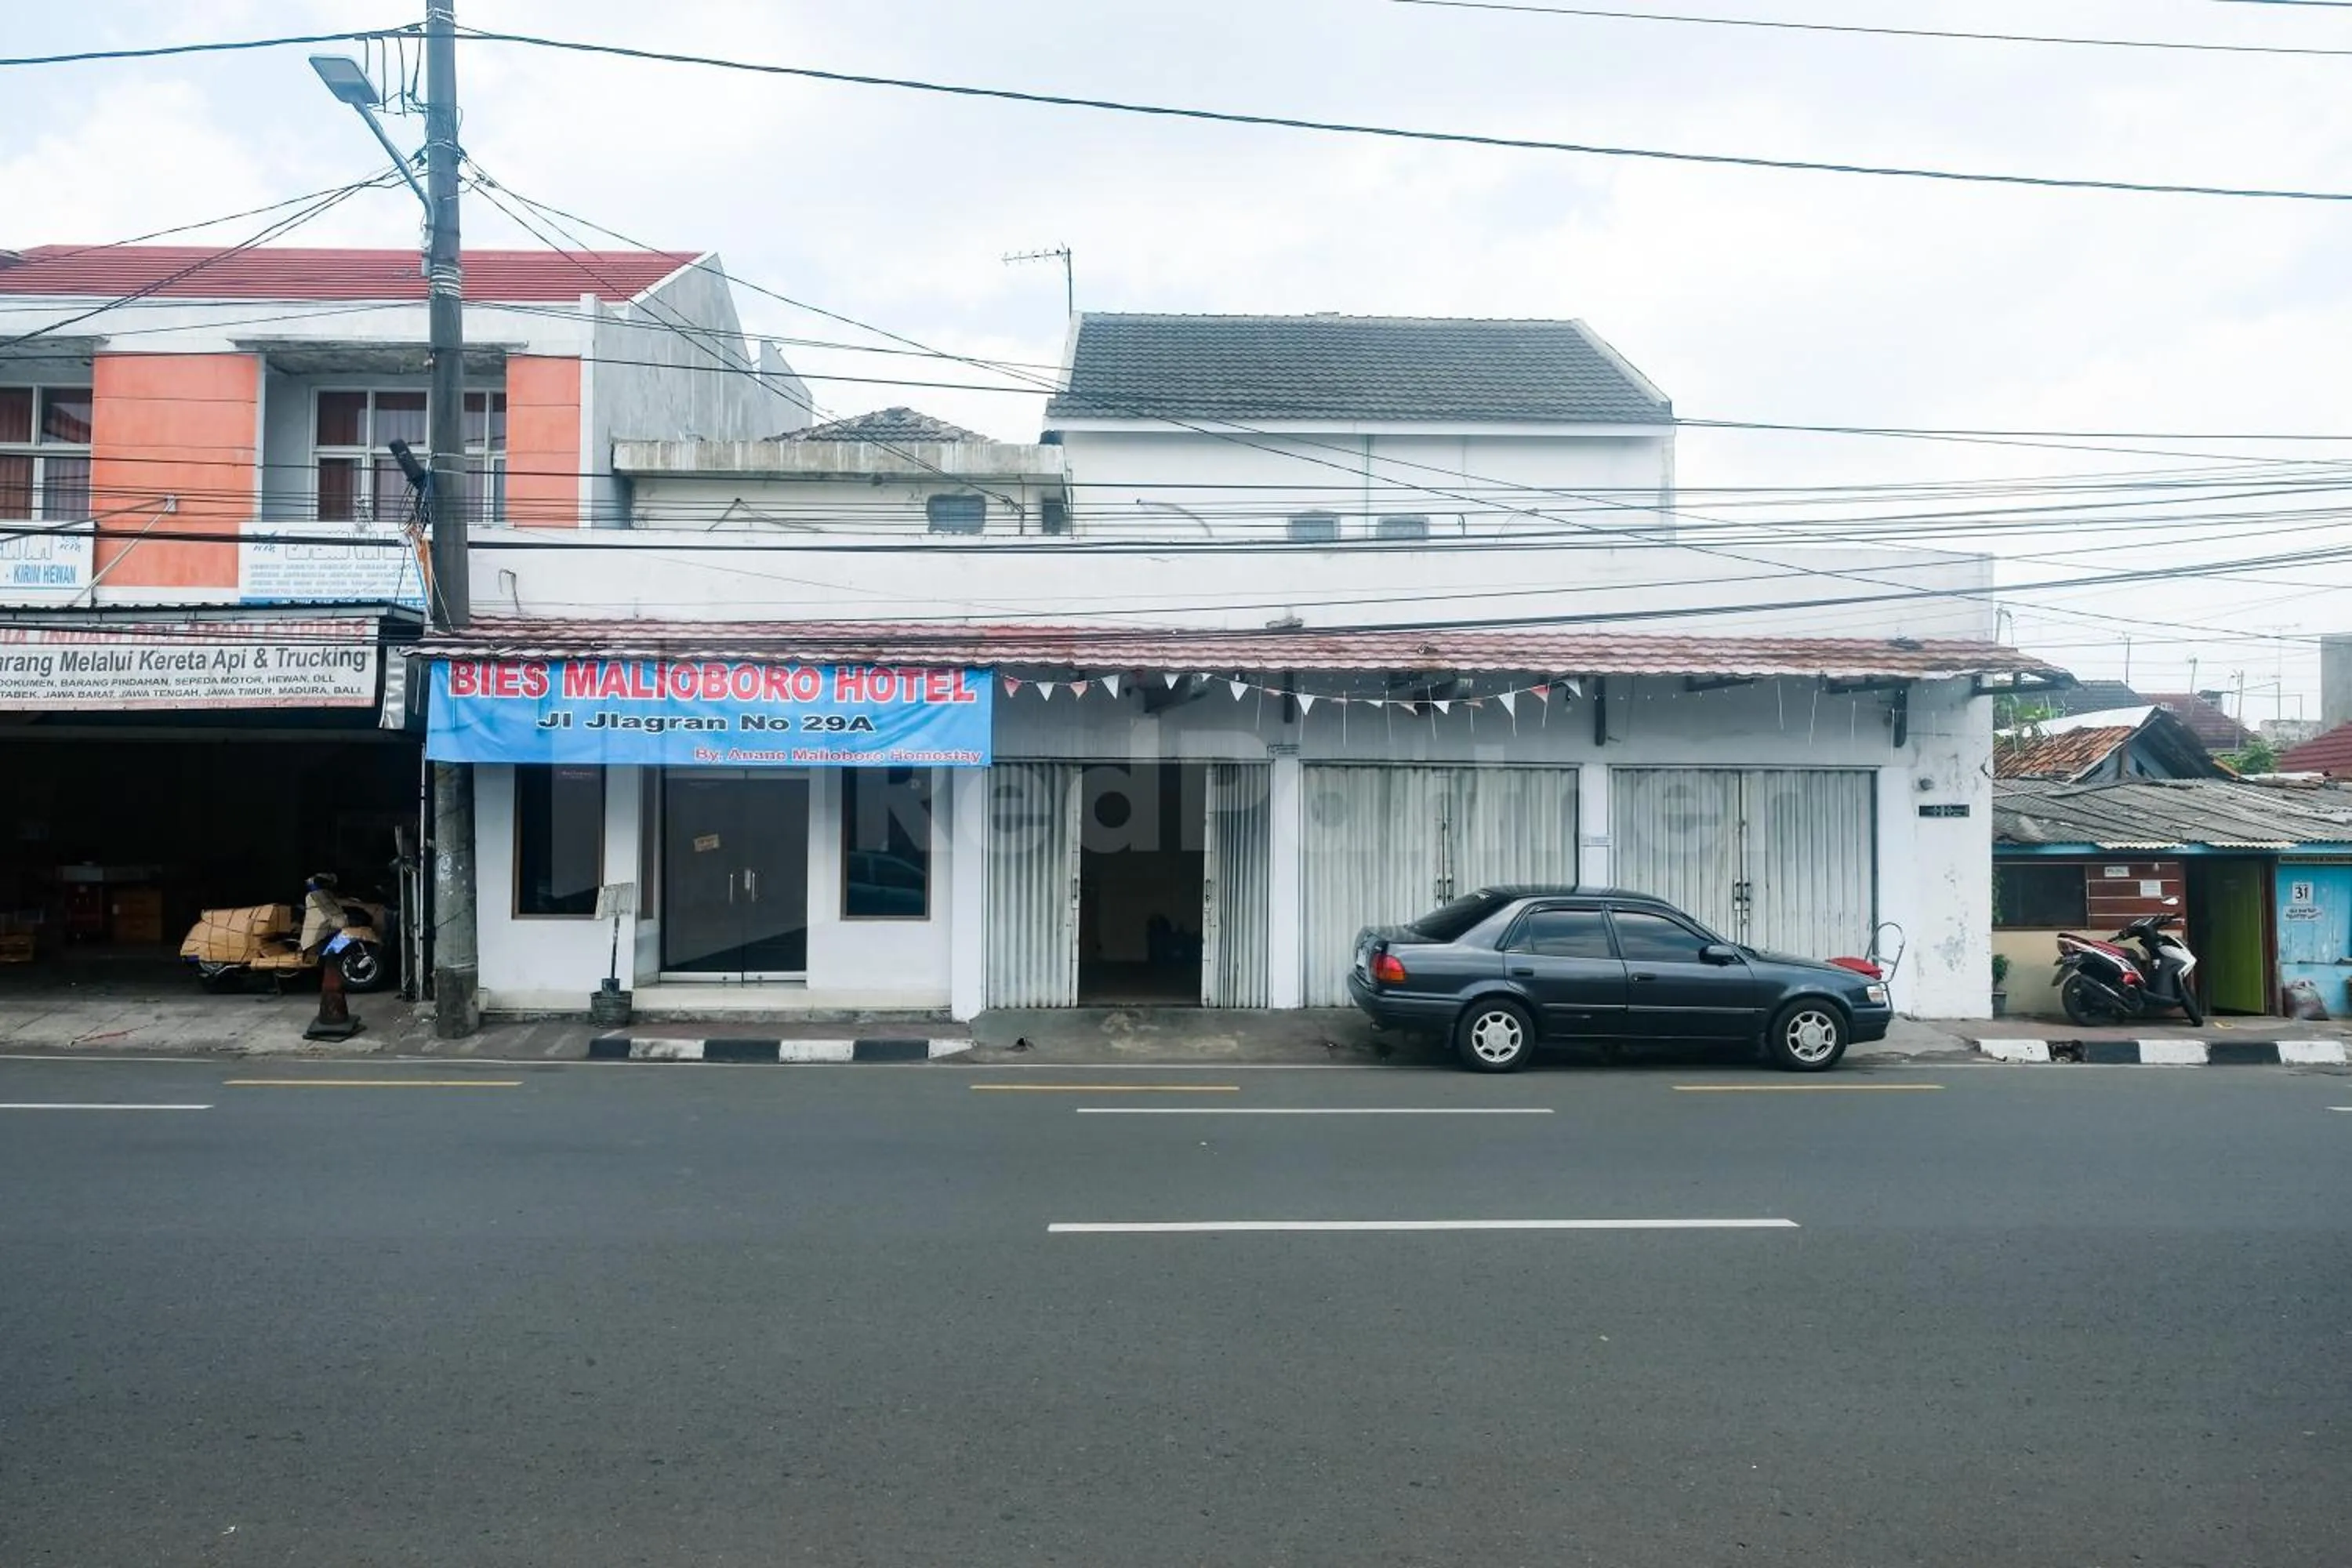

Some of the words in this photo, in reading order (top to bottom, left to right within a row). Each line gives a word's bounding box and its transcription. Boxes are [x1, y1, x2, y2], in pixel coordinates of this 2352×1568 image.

[14, 564, 41, 584] KIRIM
[43, 564, 76, 584] HEWAN
[60, 650, 133, 672] Melalui
[140, 649, 207, 670] Kereta
[212, 648, 247, 673] Api
[253, 648, 268, 668] &
[276, 647, 367, 673] Trucking
[60, 678, 108, 688] BARANG
[175, 677, 219, 685] SEPEDA
[448, 659, 550, 700] BIES
[562, 660, 823, 703] MALIOBORO
[833, 666, 978, 703] HOTEL
[119, 689, 150, 698] JAWA
[204, 688, 235, 696] JAWA
[583, 711, 728, 735] Jlagran
[739, 714, 791, 731] No
[800, 714, 877, 733] 29A
[2295, 884, 2310, 901] 31
